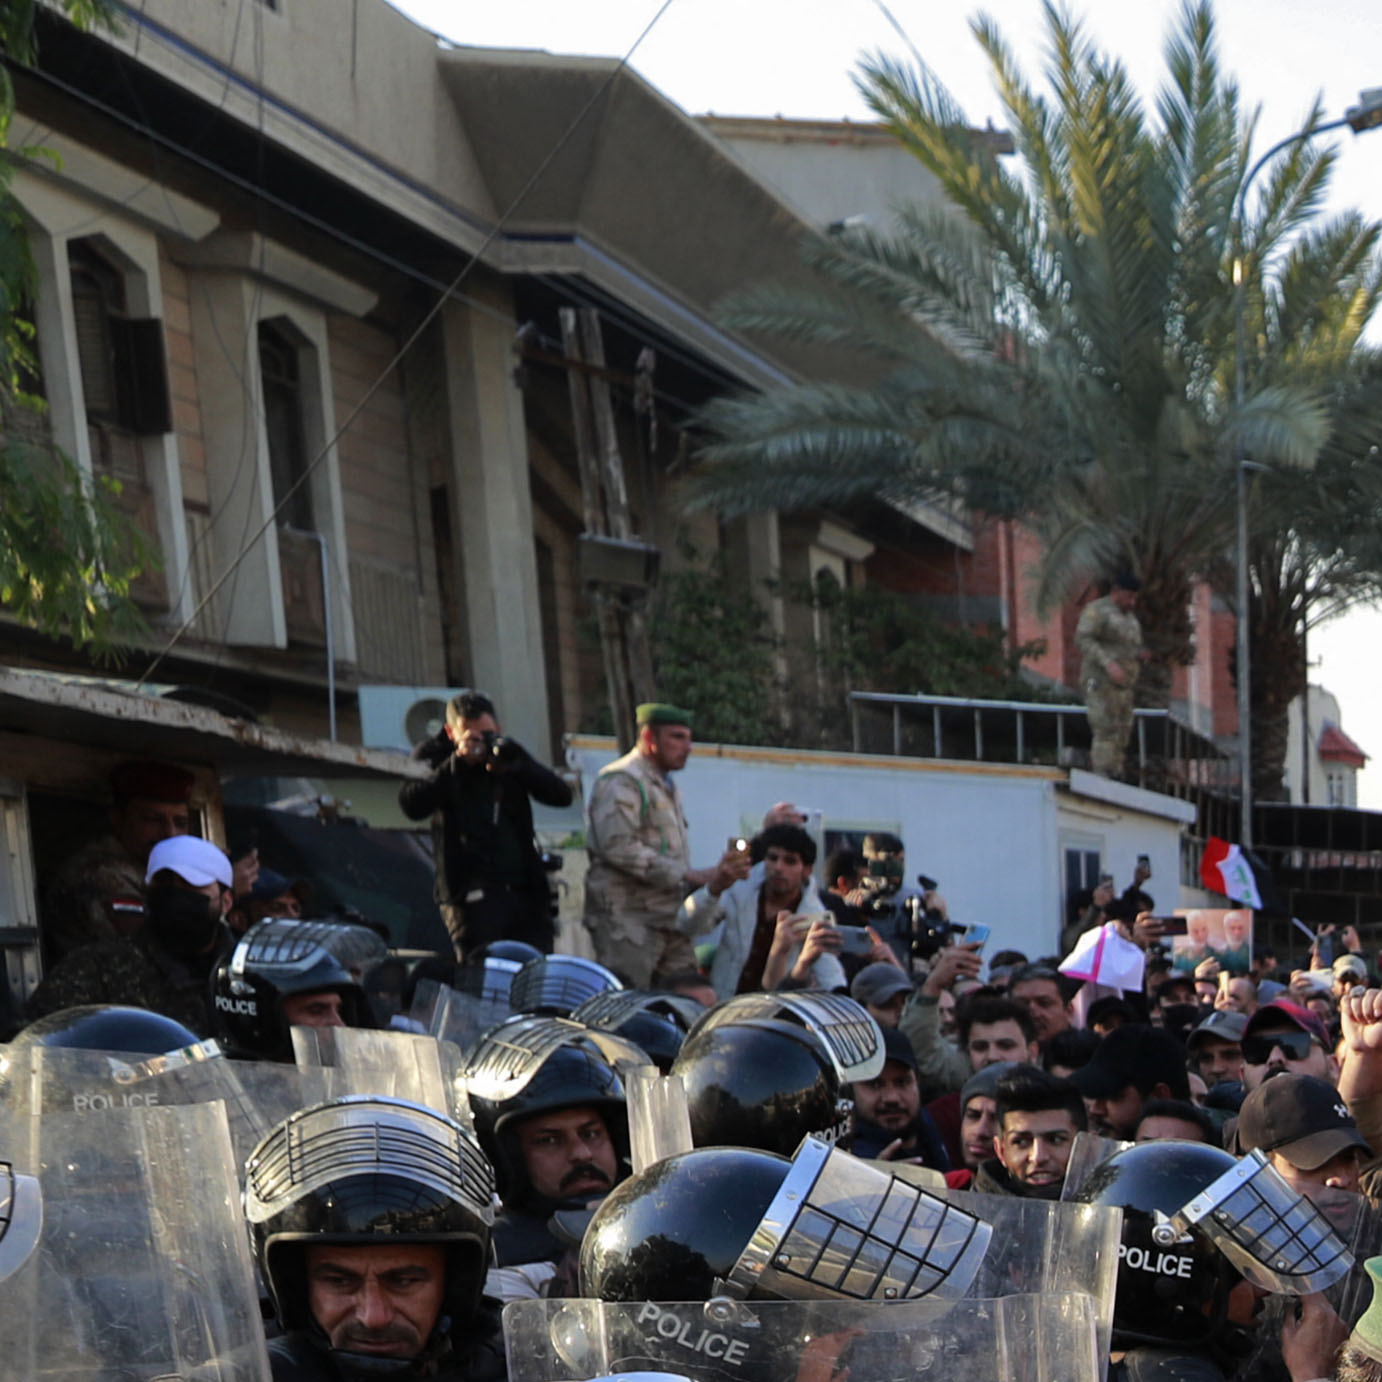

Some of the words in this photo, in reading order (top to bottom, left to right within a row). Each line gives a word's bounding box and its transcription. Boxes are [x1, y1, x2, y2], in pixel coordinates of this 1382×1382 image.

[215, 995, 257, 1016] POLICE
[1119, 1243, 1194, 1278] POLICE
[638, 1300, 750, 1366] POLICE
